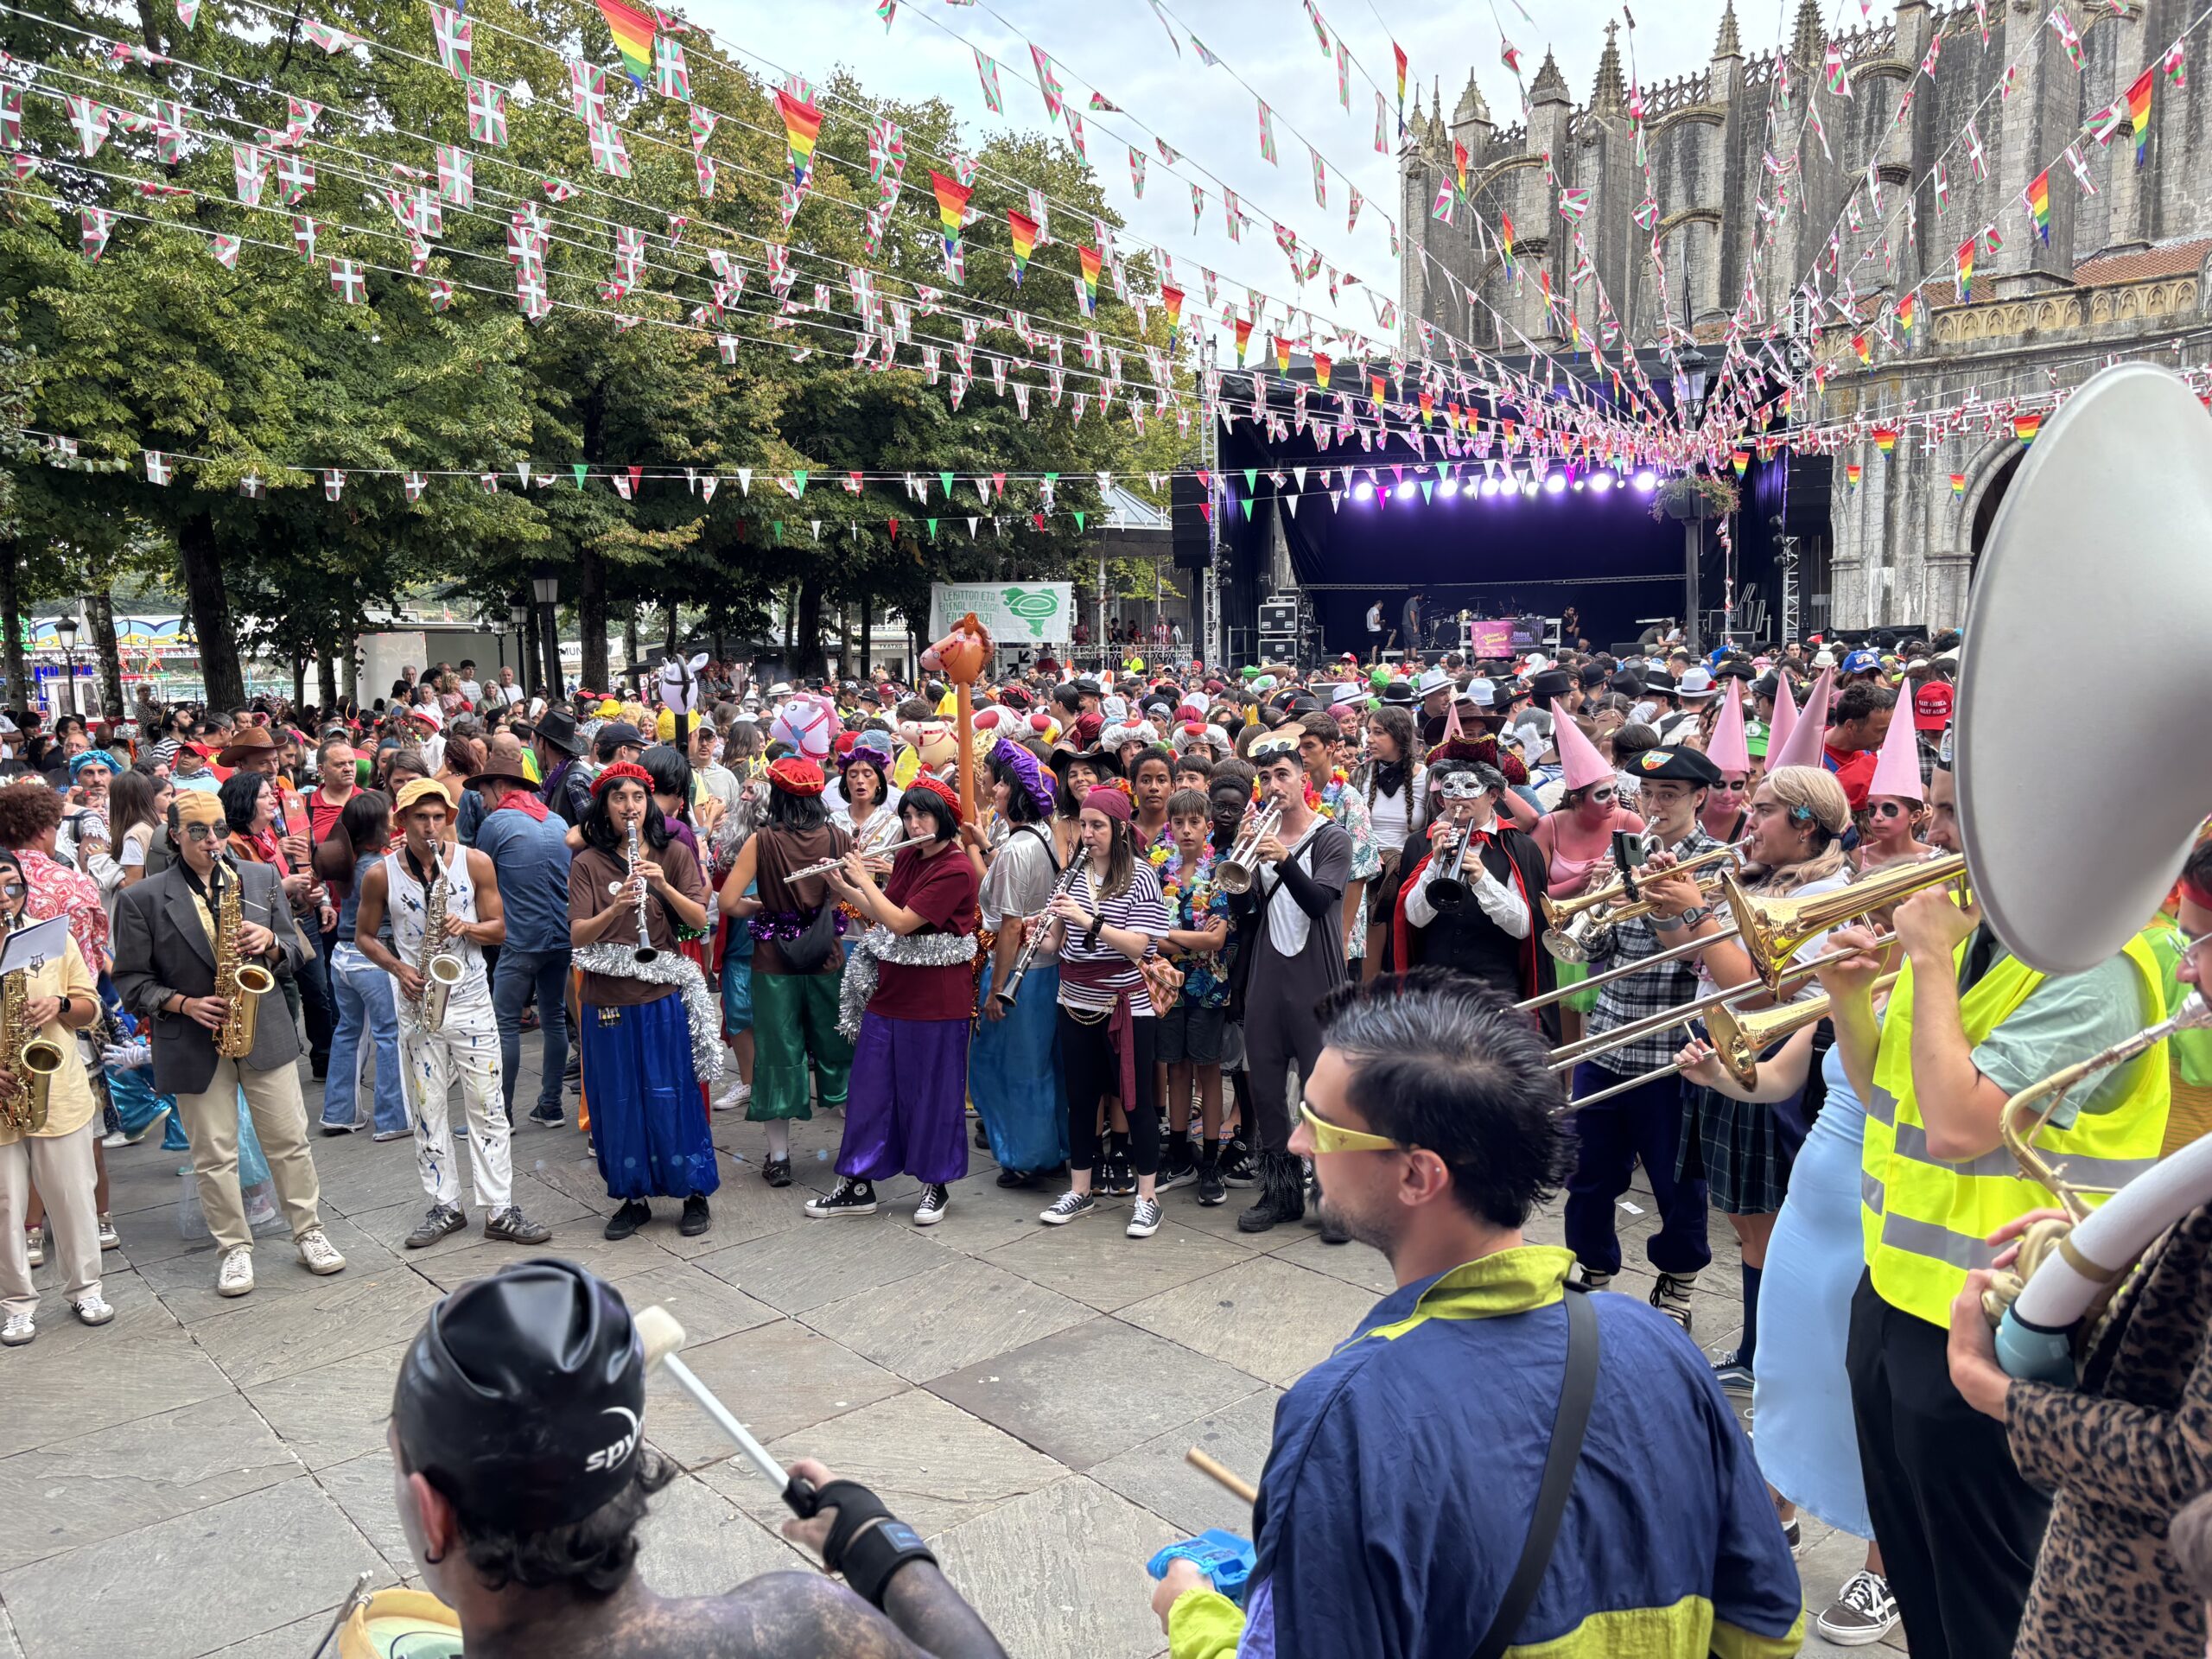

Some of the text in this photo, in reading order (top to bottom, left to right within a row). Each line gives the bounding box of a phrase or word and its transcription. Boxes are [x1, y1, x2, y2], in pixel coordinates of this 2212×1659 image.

[981, 591, 995, 601] ETA
[938, 601, 1000, 613] EUSKAL HERRIAN
[1749, 726, 1757, 734] L
